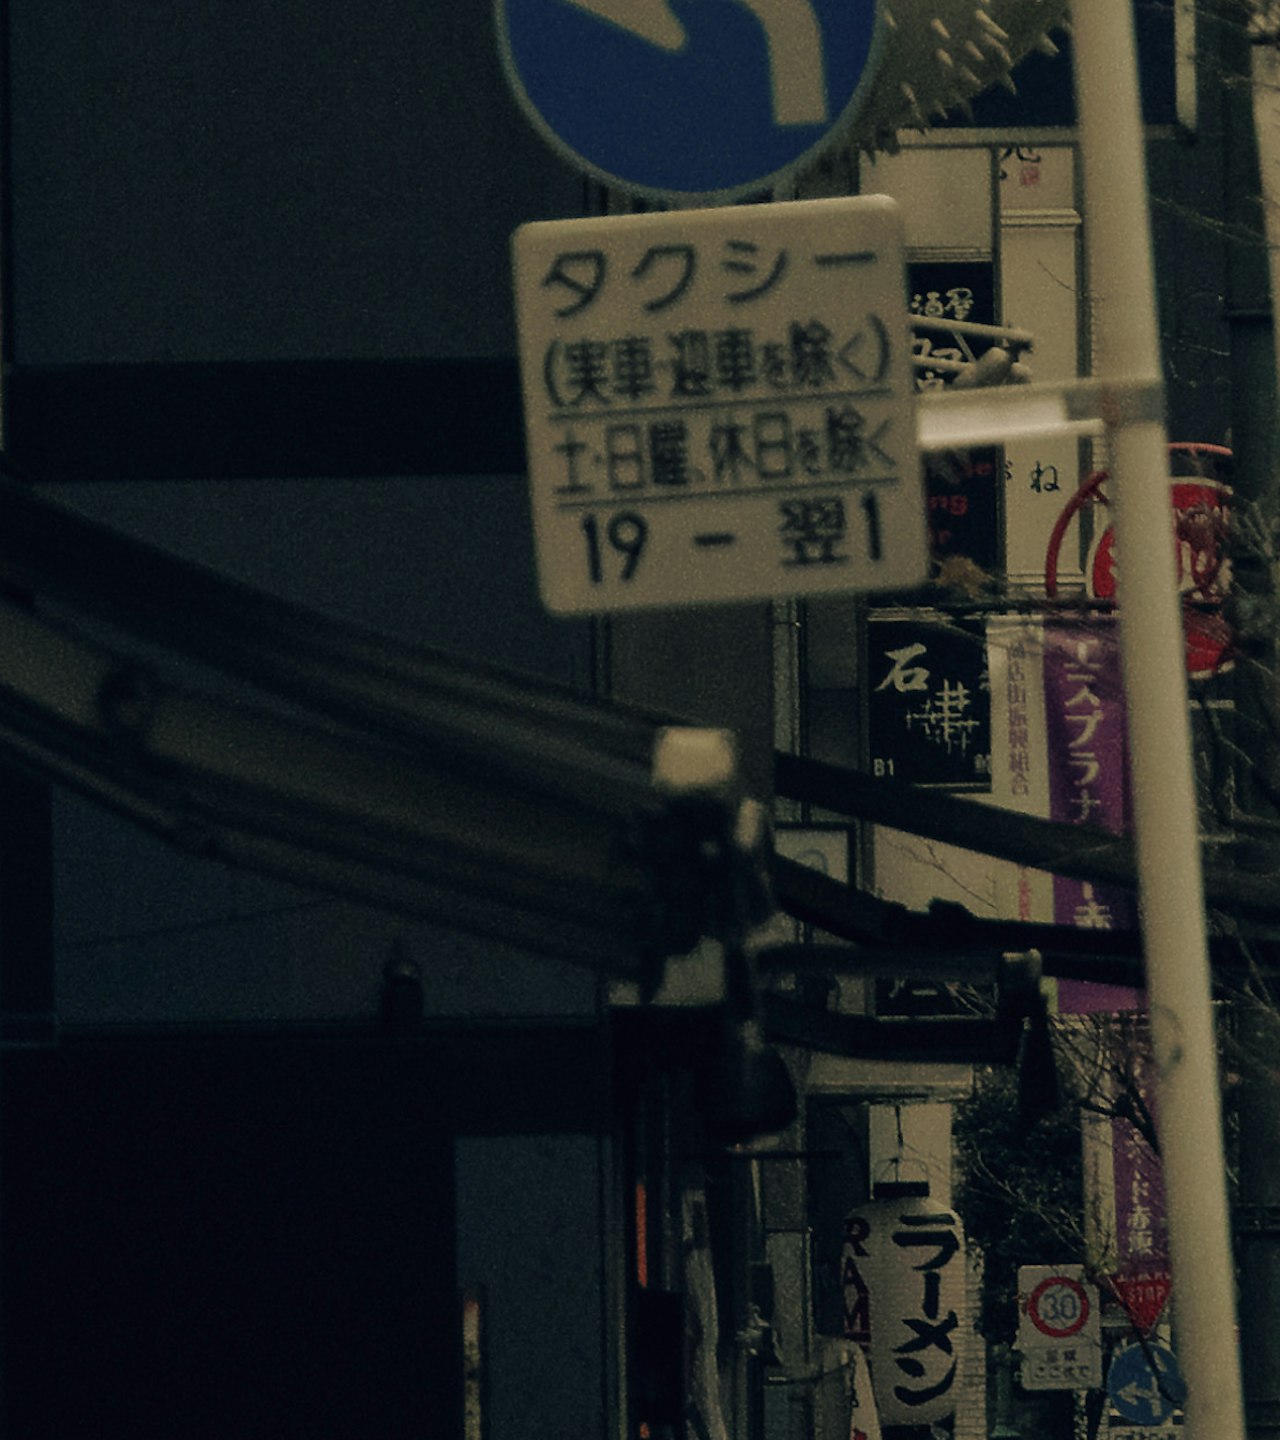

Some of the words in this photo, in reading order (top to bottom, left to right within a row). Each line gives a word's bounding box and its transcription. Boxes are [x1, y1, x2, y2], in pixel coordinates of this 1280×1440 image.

[542, 240, 877, 318] タクシー
[873, 758, 895, 777] B1
[1126, 1282, 1166, 1305] STOP
[892, 1214, 959, 1406] ラーメン
[1042, 1294, 1078, 1321] 30
